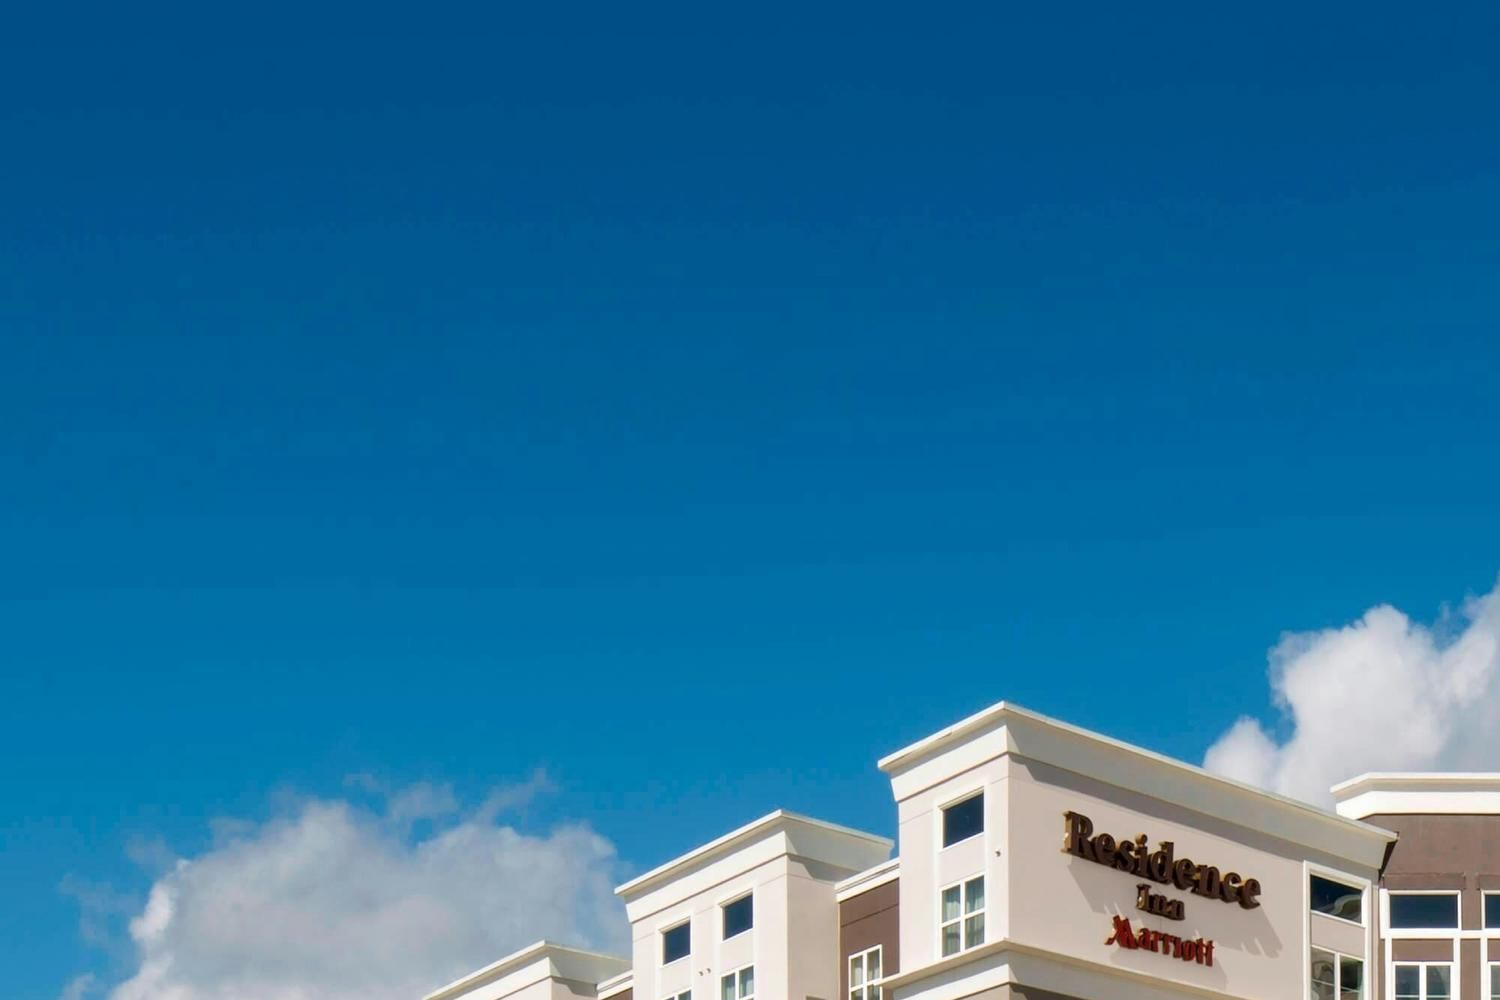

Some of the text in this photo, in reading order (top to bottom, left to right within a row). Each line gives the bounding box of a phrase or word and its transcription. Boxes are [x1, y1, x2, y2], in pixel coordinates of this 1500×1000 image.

[1061, 810, 1261, 910] Residence
[1136, 883, 1186, 921] Inn
[1104, 914, 1215, 967] Marriott
